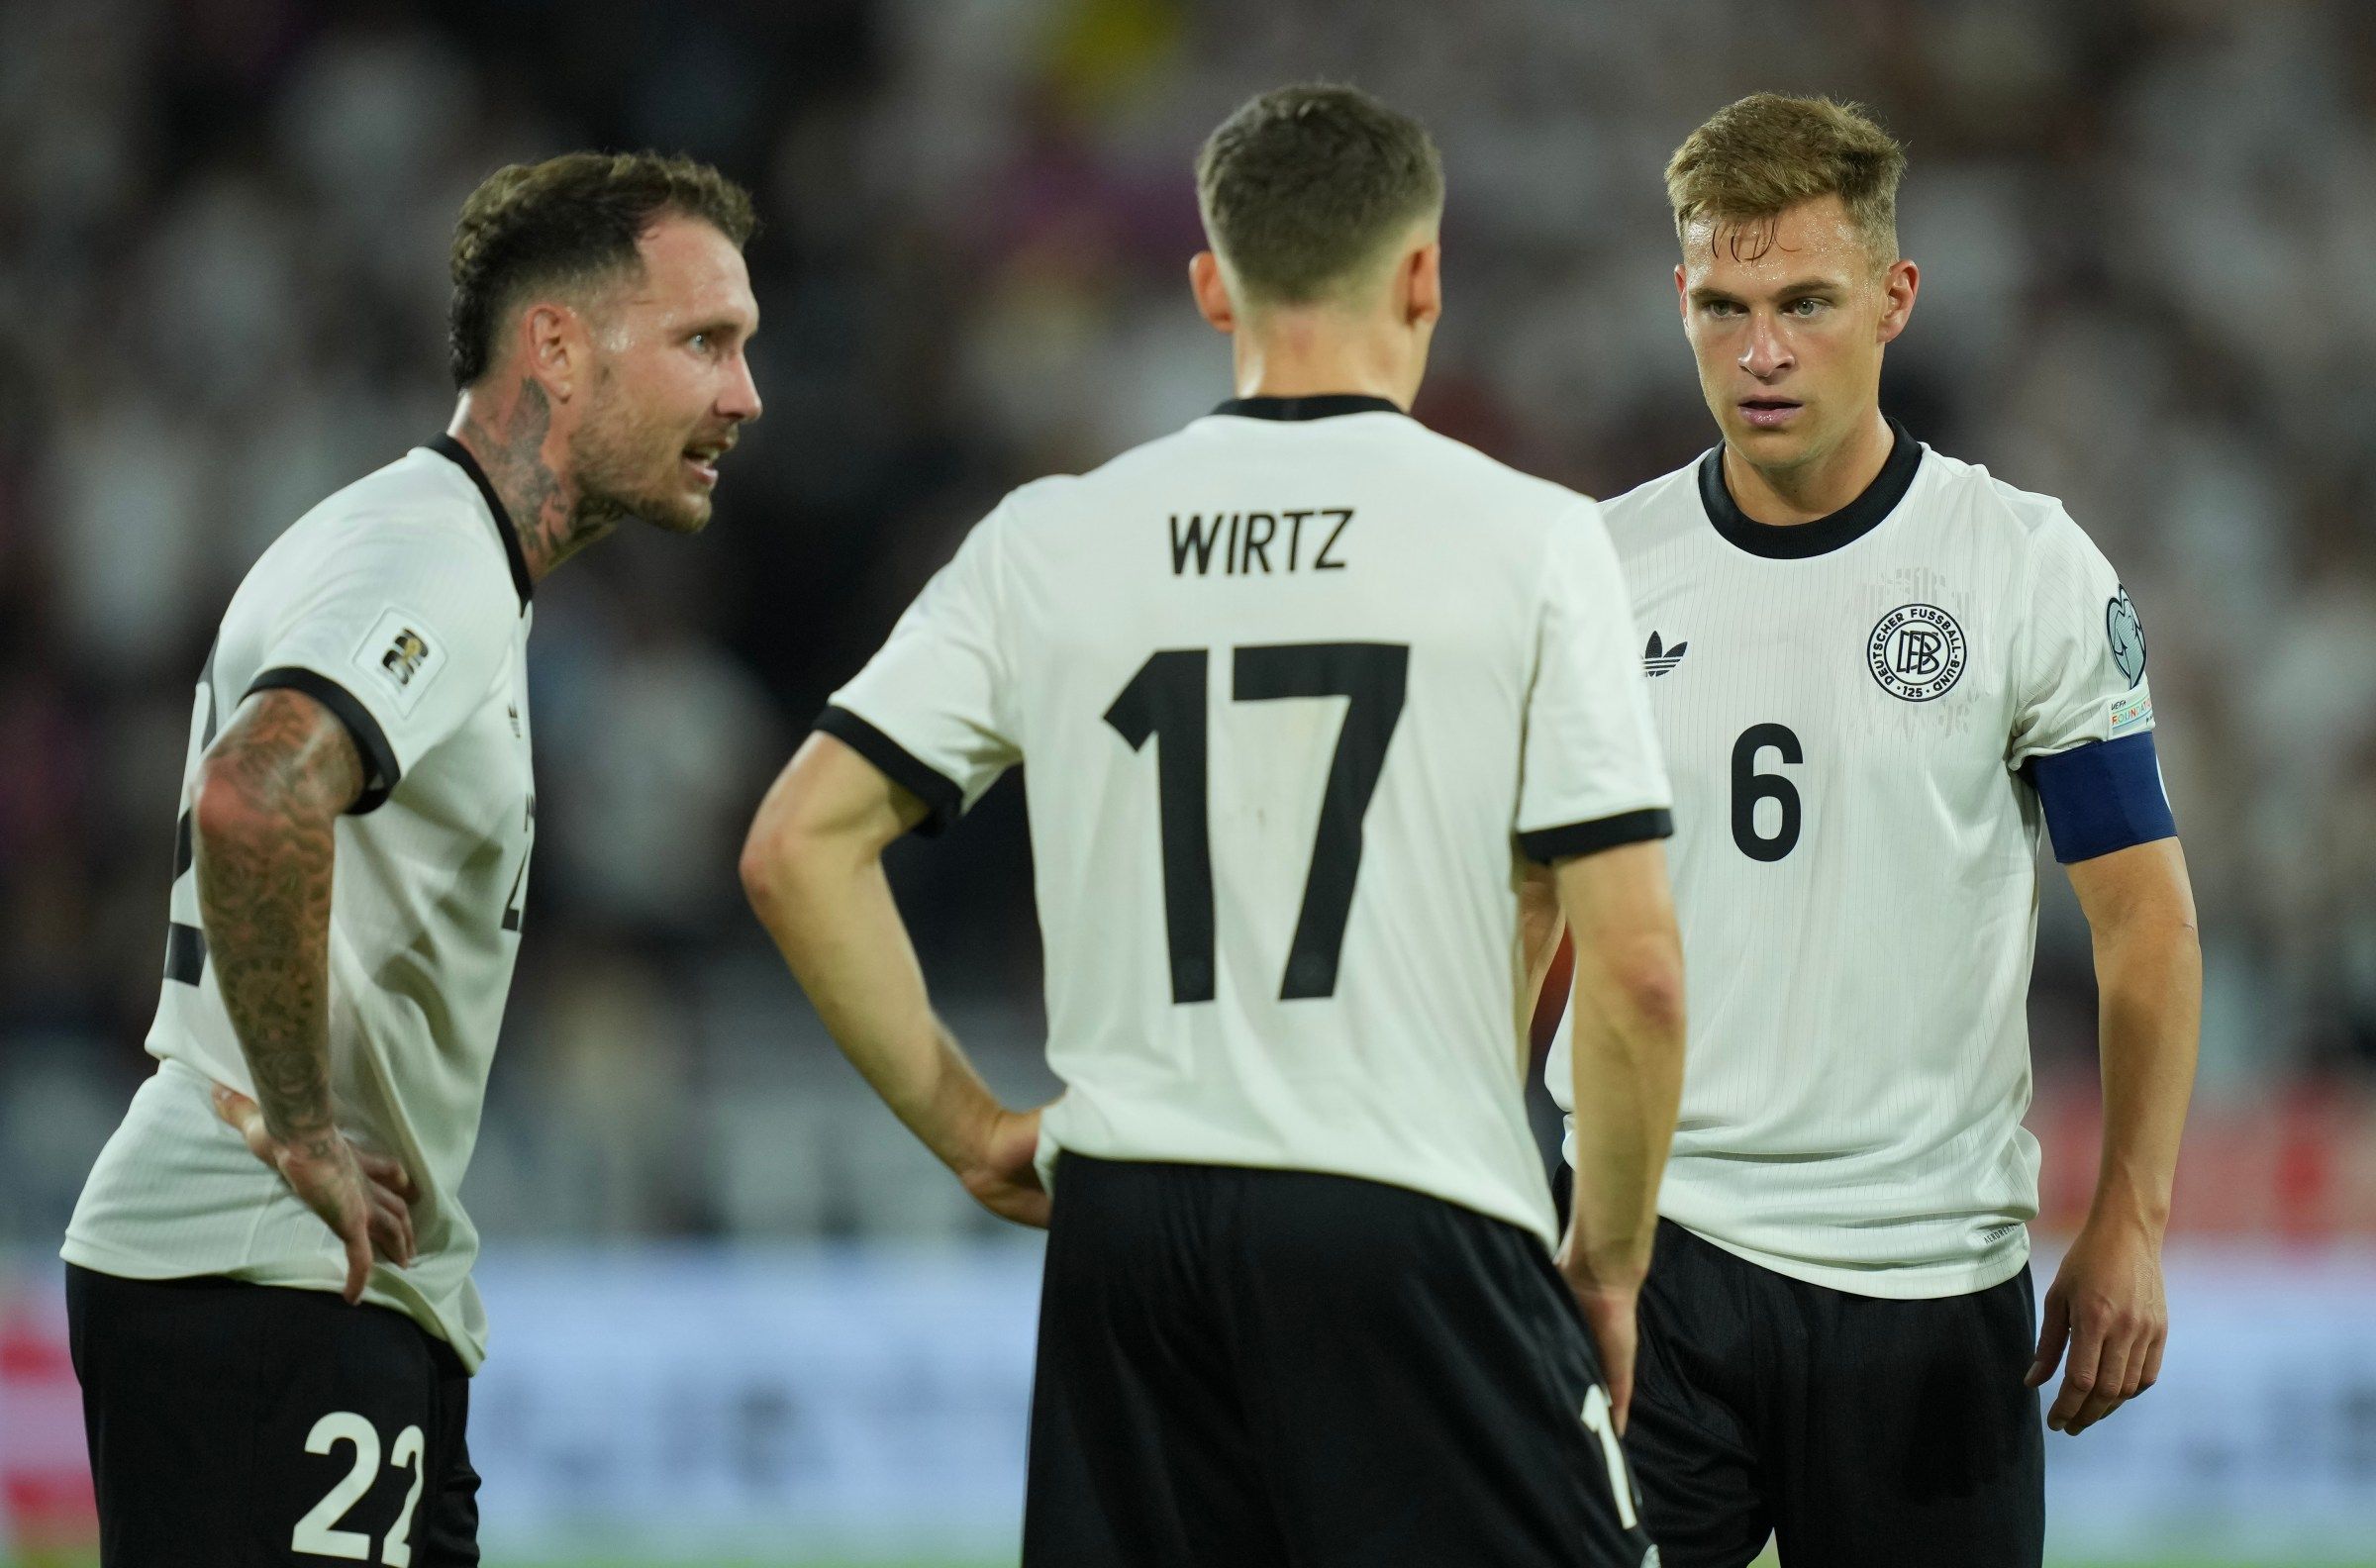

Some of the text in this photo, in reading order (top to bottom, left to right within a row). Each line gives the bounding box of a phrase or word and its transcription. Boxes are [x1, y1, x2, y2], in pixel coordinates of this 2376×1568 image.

[1169, 509, 1354, 576] WIRTZ
[1873, 613, 1904, 685] DEUTSCHER
[2111, 700, 2127, 711] UEFA
[1103, 642, 1411, 1004] 17
[1732, 723, 1803, 862] 6
[291, 1412, 425, 1568] 22
